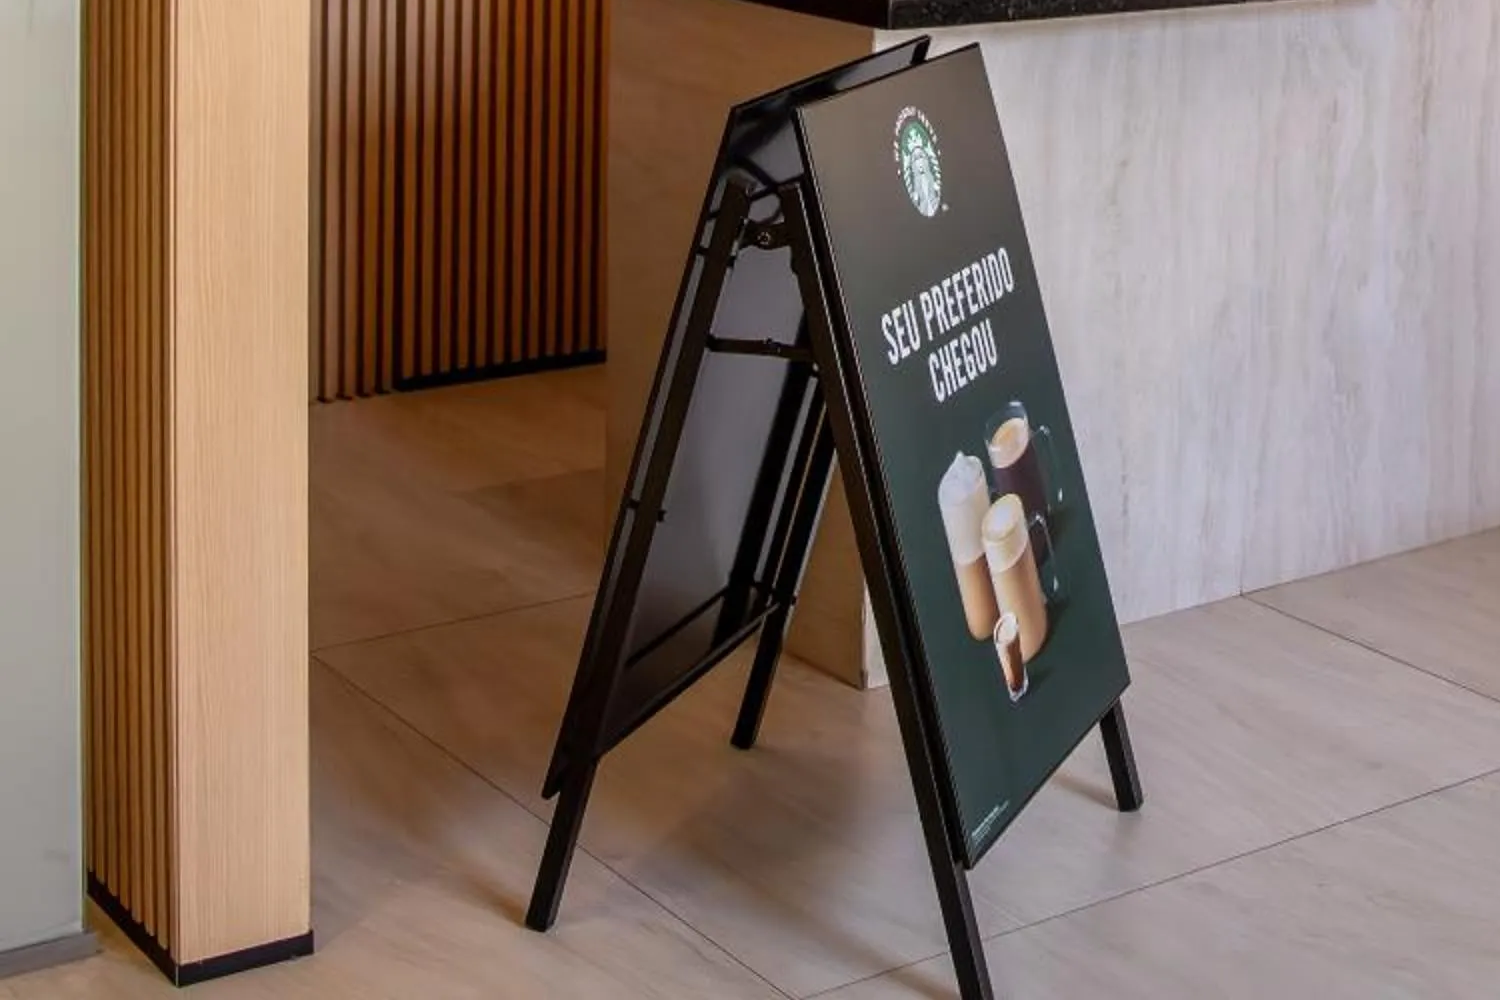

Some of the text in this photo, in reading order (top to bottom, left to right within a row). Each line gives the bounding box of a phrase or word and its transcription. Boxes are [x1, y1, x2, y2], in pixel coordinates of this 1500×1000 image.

[881, 247, 1015, 365] SEU PREFERIDO
[928, 318, 998, 403] CHEGOU
